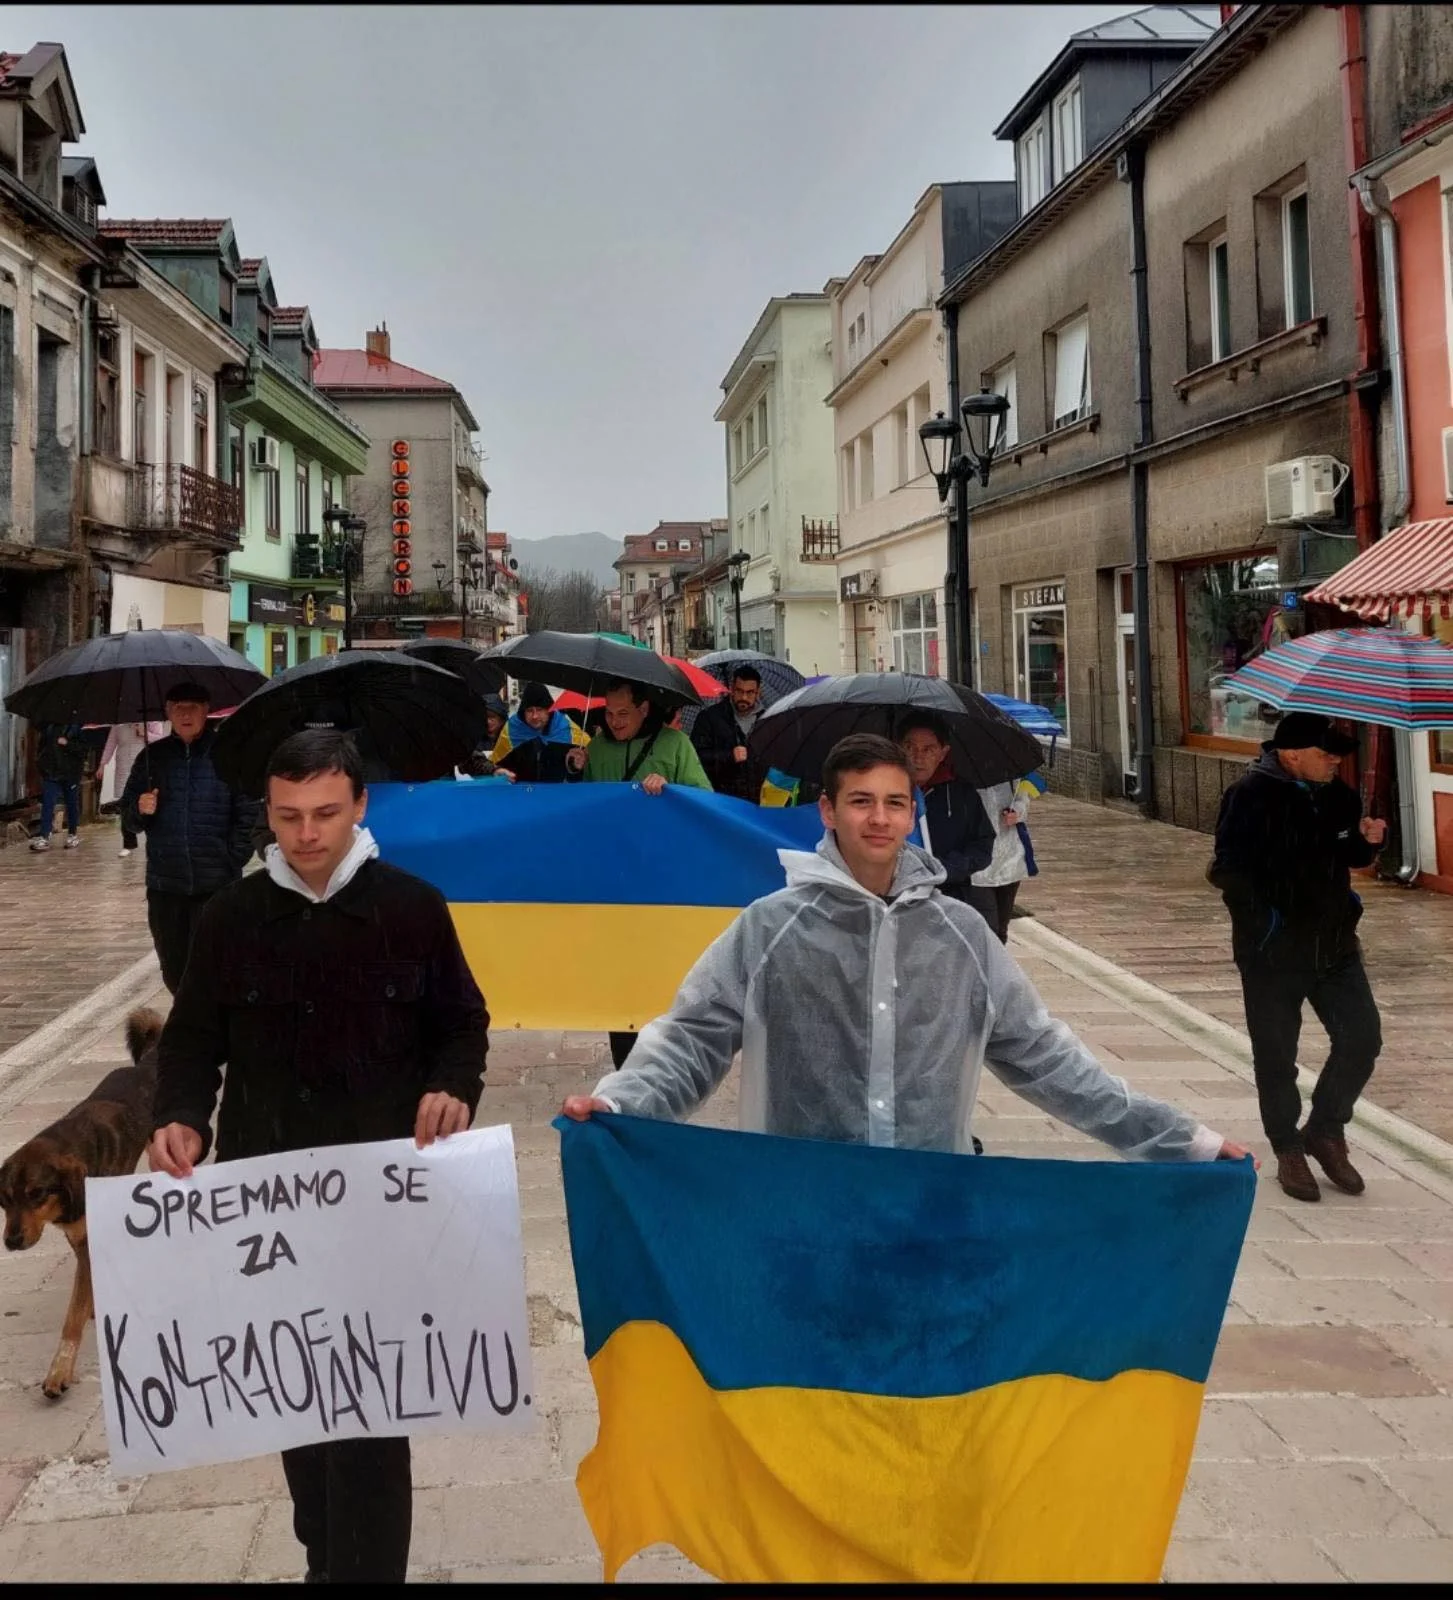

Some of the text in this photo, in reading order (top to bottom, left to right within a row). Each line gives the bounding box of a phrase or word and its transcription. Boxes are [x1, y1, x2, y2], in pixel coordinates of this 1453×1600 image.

[392, 440, 412, 595] ELEKTRON
[1023, 585, 1064, 606] STEFAN
[125, 1163, 430, 1238] SPREMAMO SE
[236, 1230, 298, 1277] ZA
